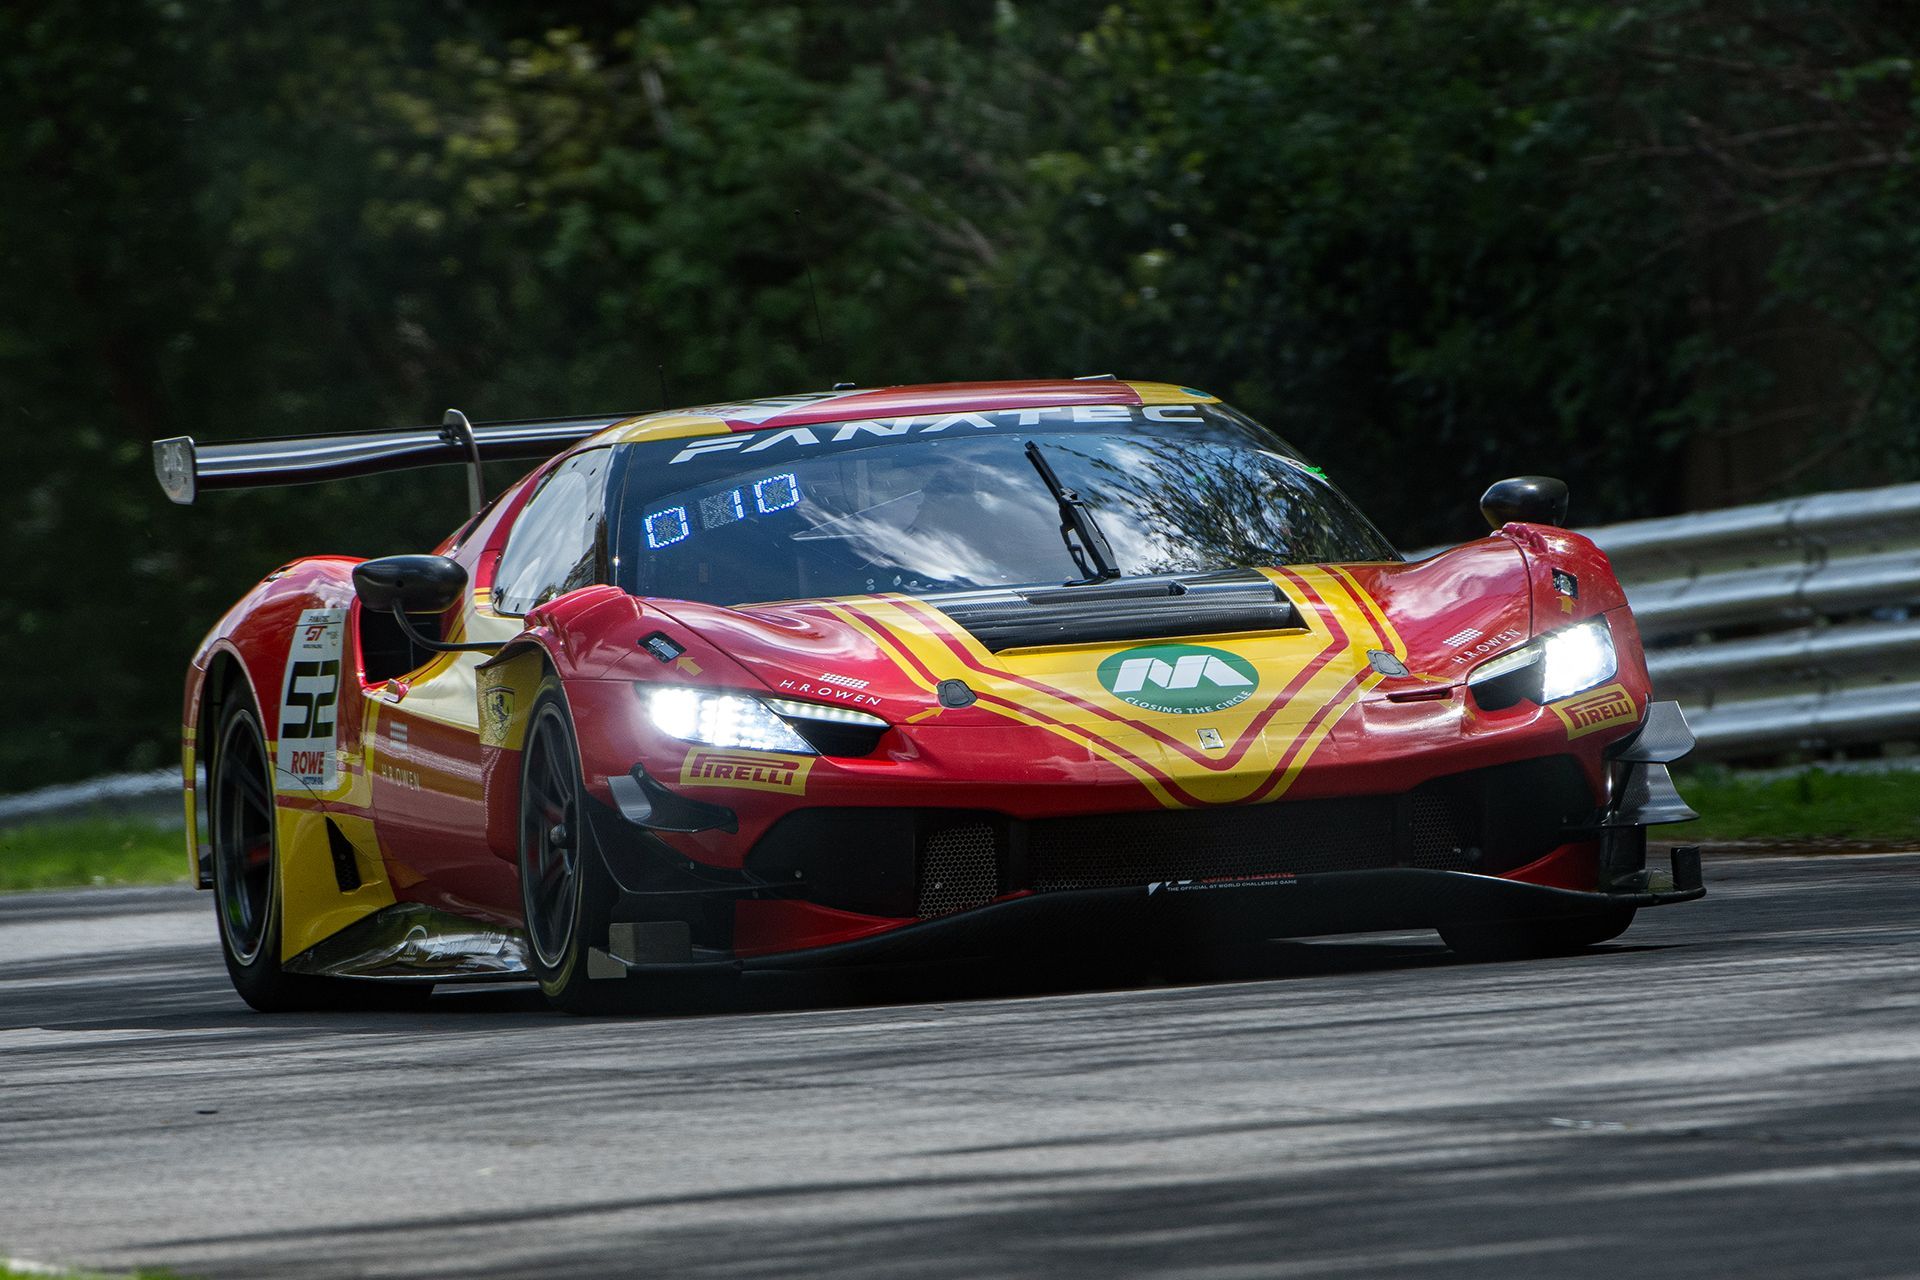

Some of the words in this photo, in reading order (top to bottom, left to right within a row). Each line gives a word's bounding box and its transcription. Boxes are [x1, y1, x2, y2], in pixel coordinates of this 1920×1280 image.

[668, 404, 1204, 464] FANATEC
[281, 660, 340, 738] 52
[779, 679, 882, 706] H.R.OWEN
[1125, 696, 1183, 714] CLOSING
[1186, 706, 1214, 714] THE
[1217, 690, 1251, 710] CIRCLE
[1562, 691, 1632, 729] PIRELLI
[291, 751, 325, 774] ROWE
[690, 753, 800, 786] PIRELLI
